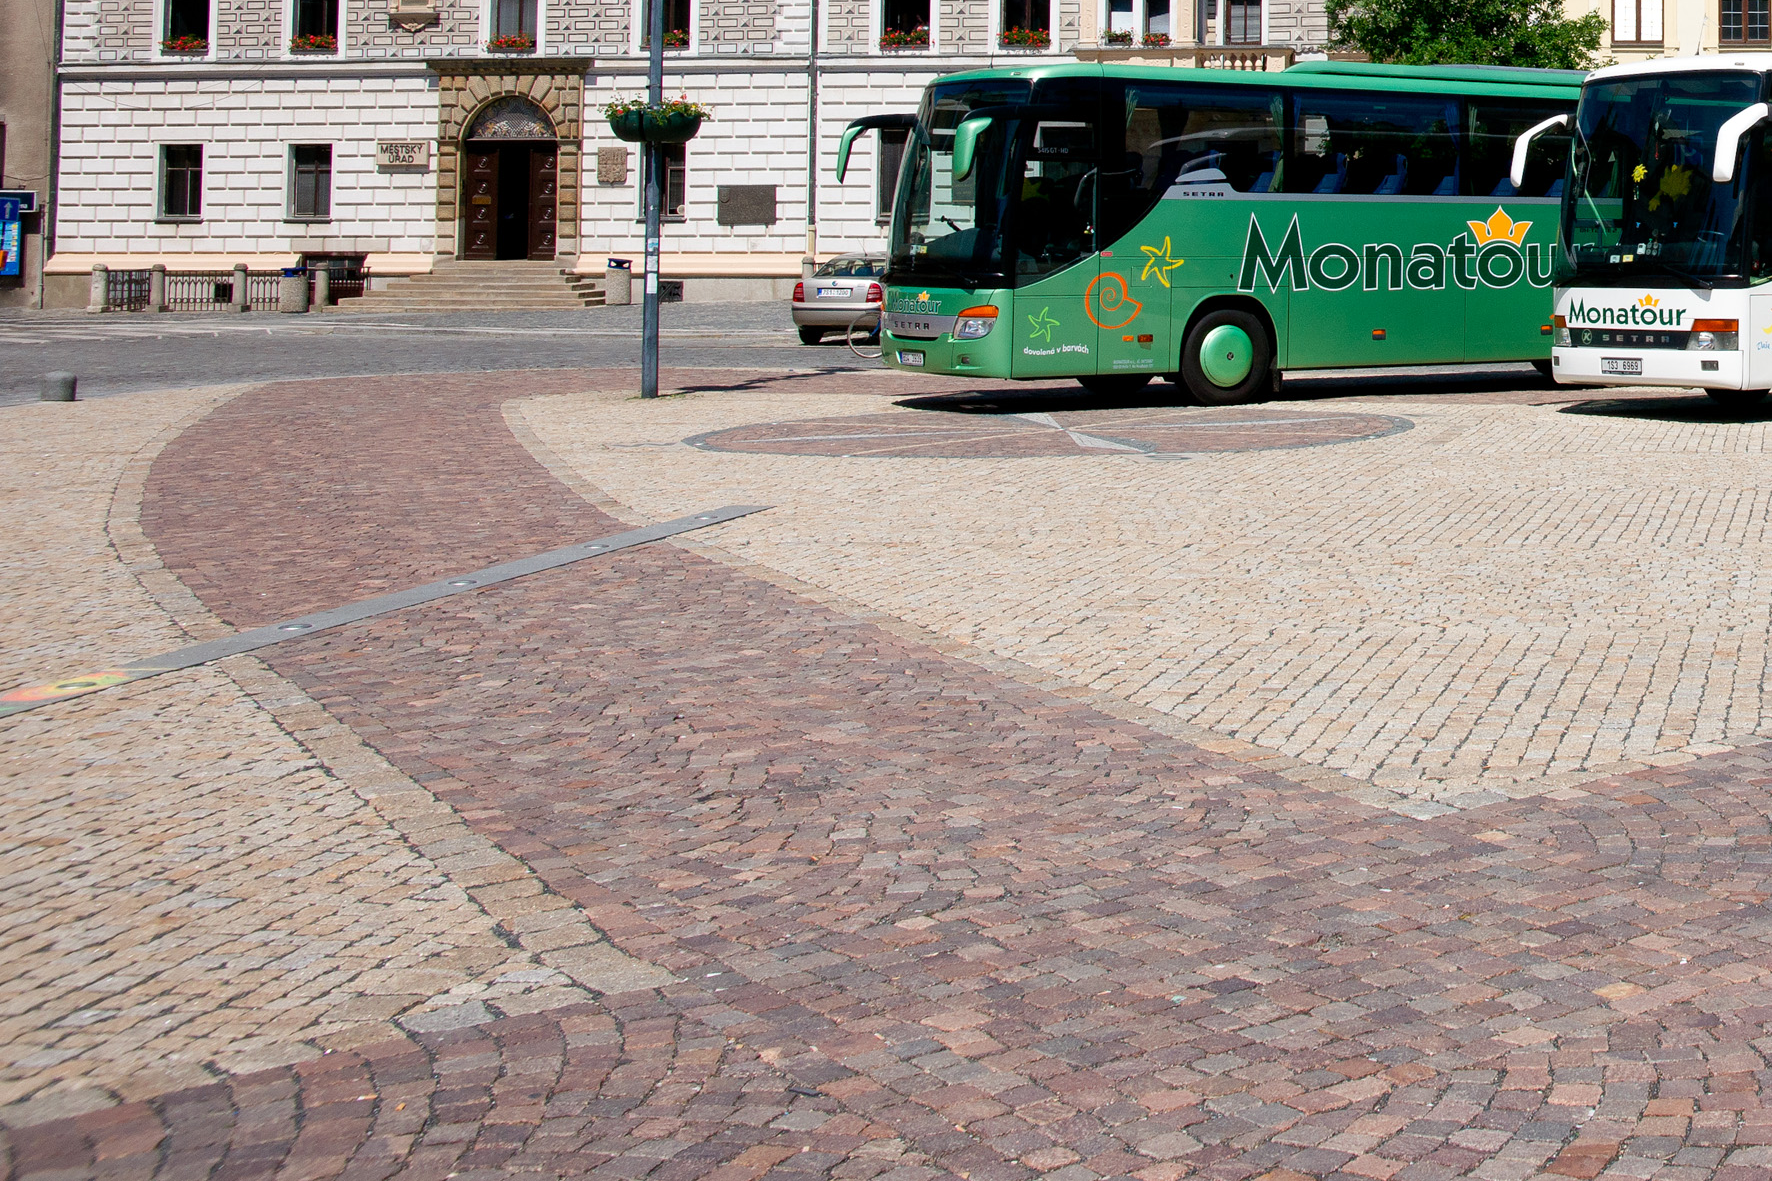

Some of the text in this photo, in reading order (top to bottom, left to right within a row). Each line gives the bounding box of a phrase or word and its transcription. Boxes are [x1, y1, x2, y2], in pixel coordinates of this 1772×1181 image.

[1568, 297, 1687, 326] Monatour
[894, 321, 931, 330] SETRA
[1602, 334, 1670, 343] SETRA
[1607, 360, 1639, 371] 1S3 6969
